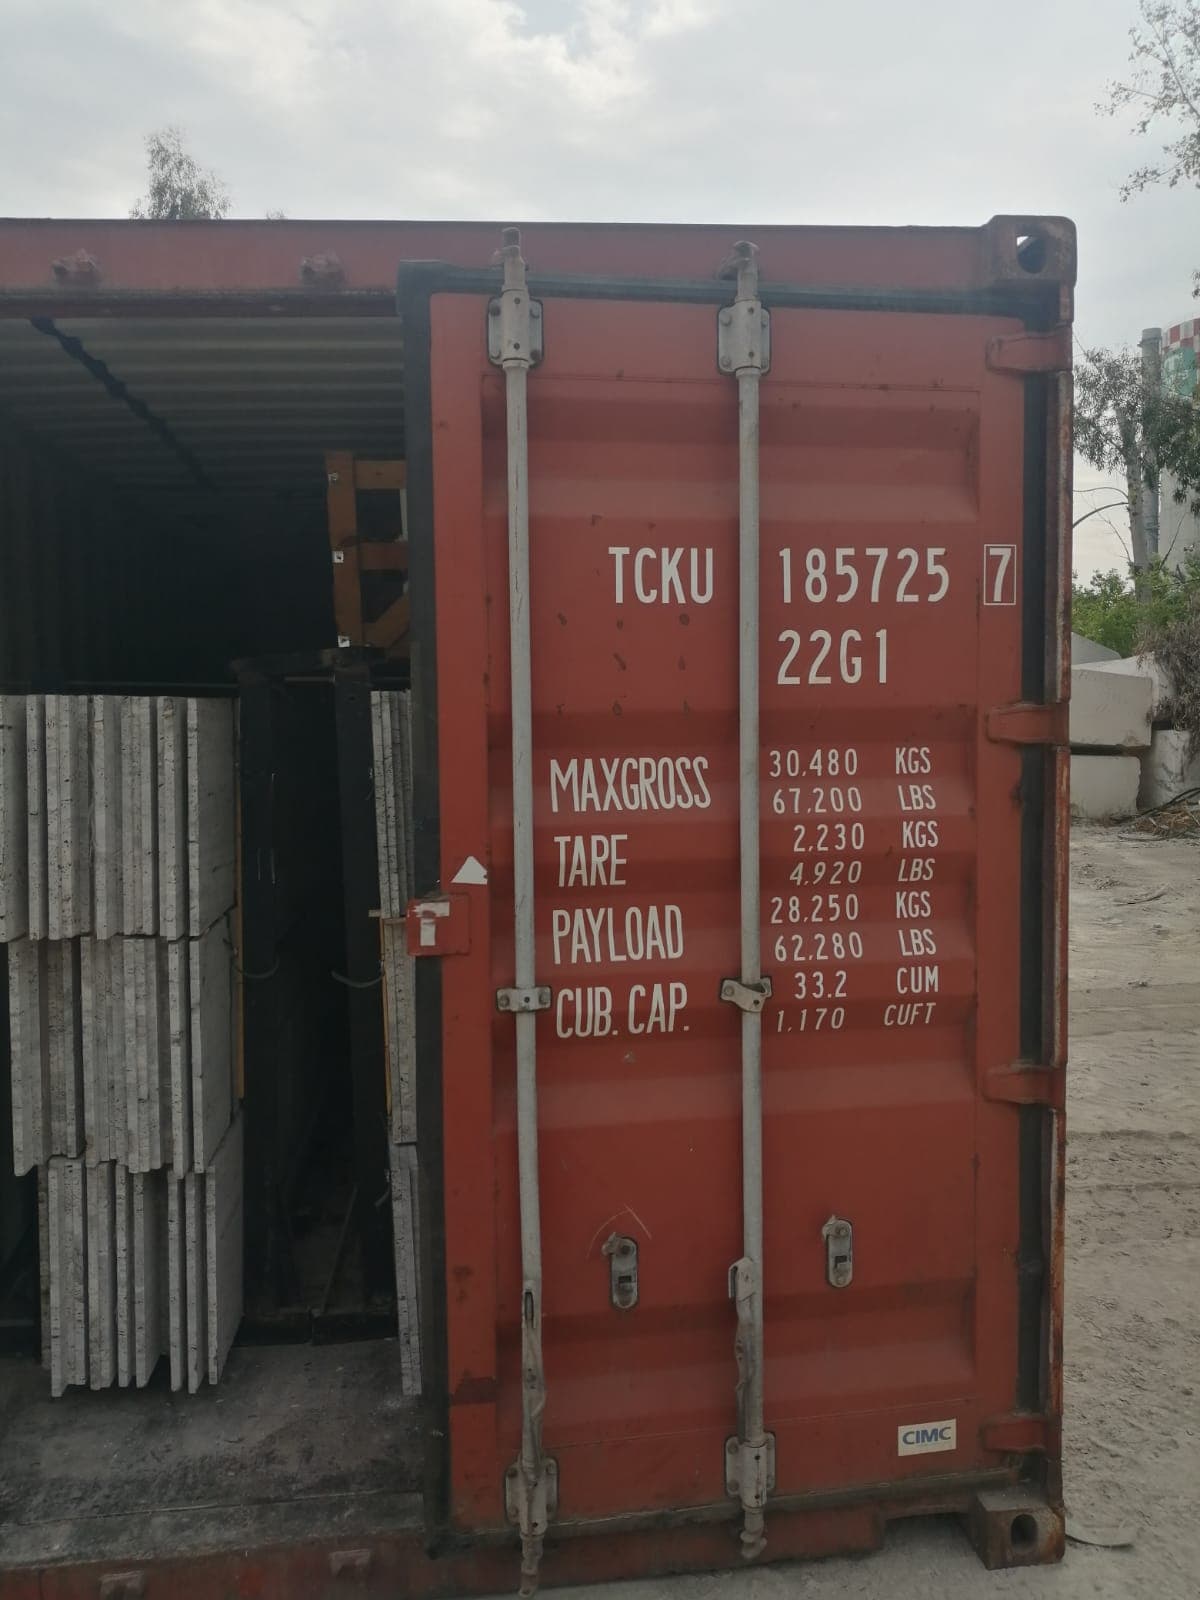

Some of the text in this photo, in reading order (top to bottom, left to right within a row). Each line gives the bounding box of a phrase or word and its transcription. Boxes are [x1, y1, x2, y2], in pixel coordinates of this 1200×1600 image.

[608, 546, 1012, 604] TCKU 185725 7
[777, 629, 887, 685] 22G1
[550, 756, 711, 813] MAXGROSS
[895, 747, 931, 775] KGS
[898, 784, 936, 811] LBS
[554, 834, 628, 886] TARE
[902, 820, 939, 849] KGS
[898, 858, 936, 882] LBS
[552, 905, 684, 964] PAYLOAD
[895, 890, 931, 919] KGS
[898, 928, 937, 956] LBS
[794, 970, 847, 999] 33.2
[896, 965, 939, 994] CUM
[883, 1002, 937, 1026] CUFT
[902, 1426, 952, 1445] CIMC
